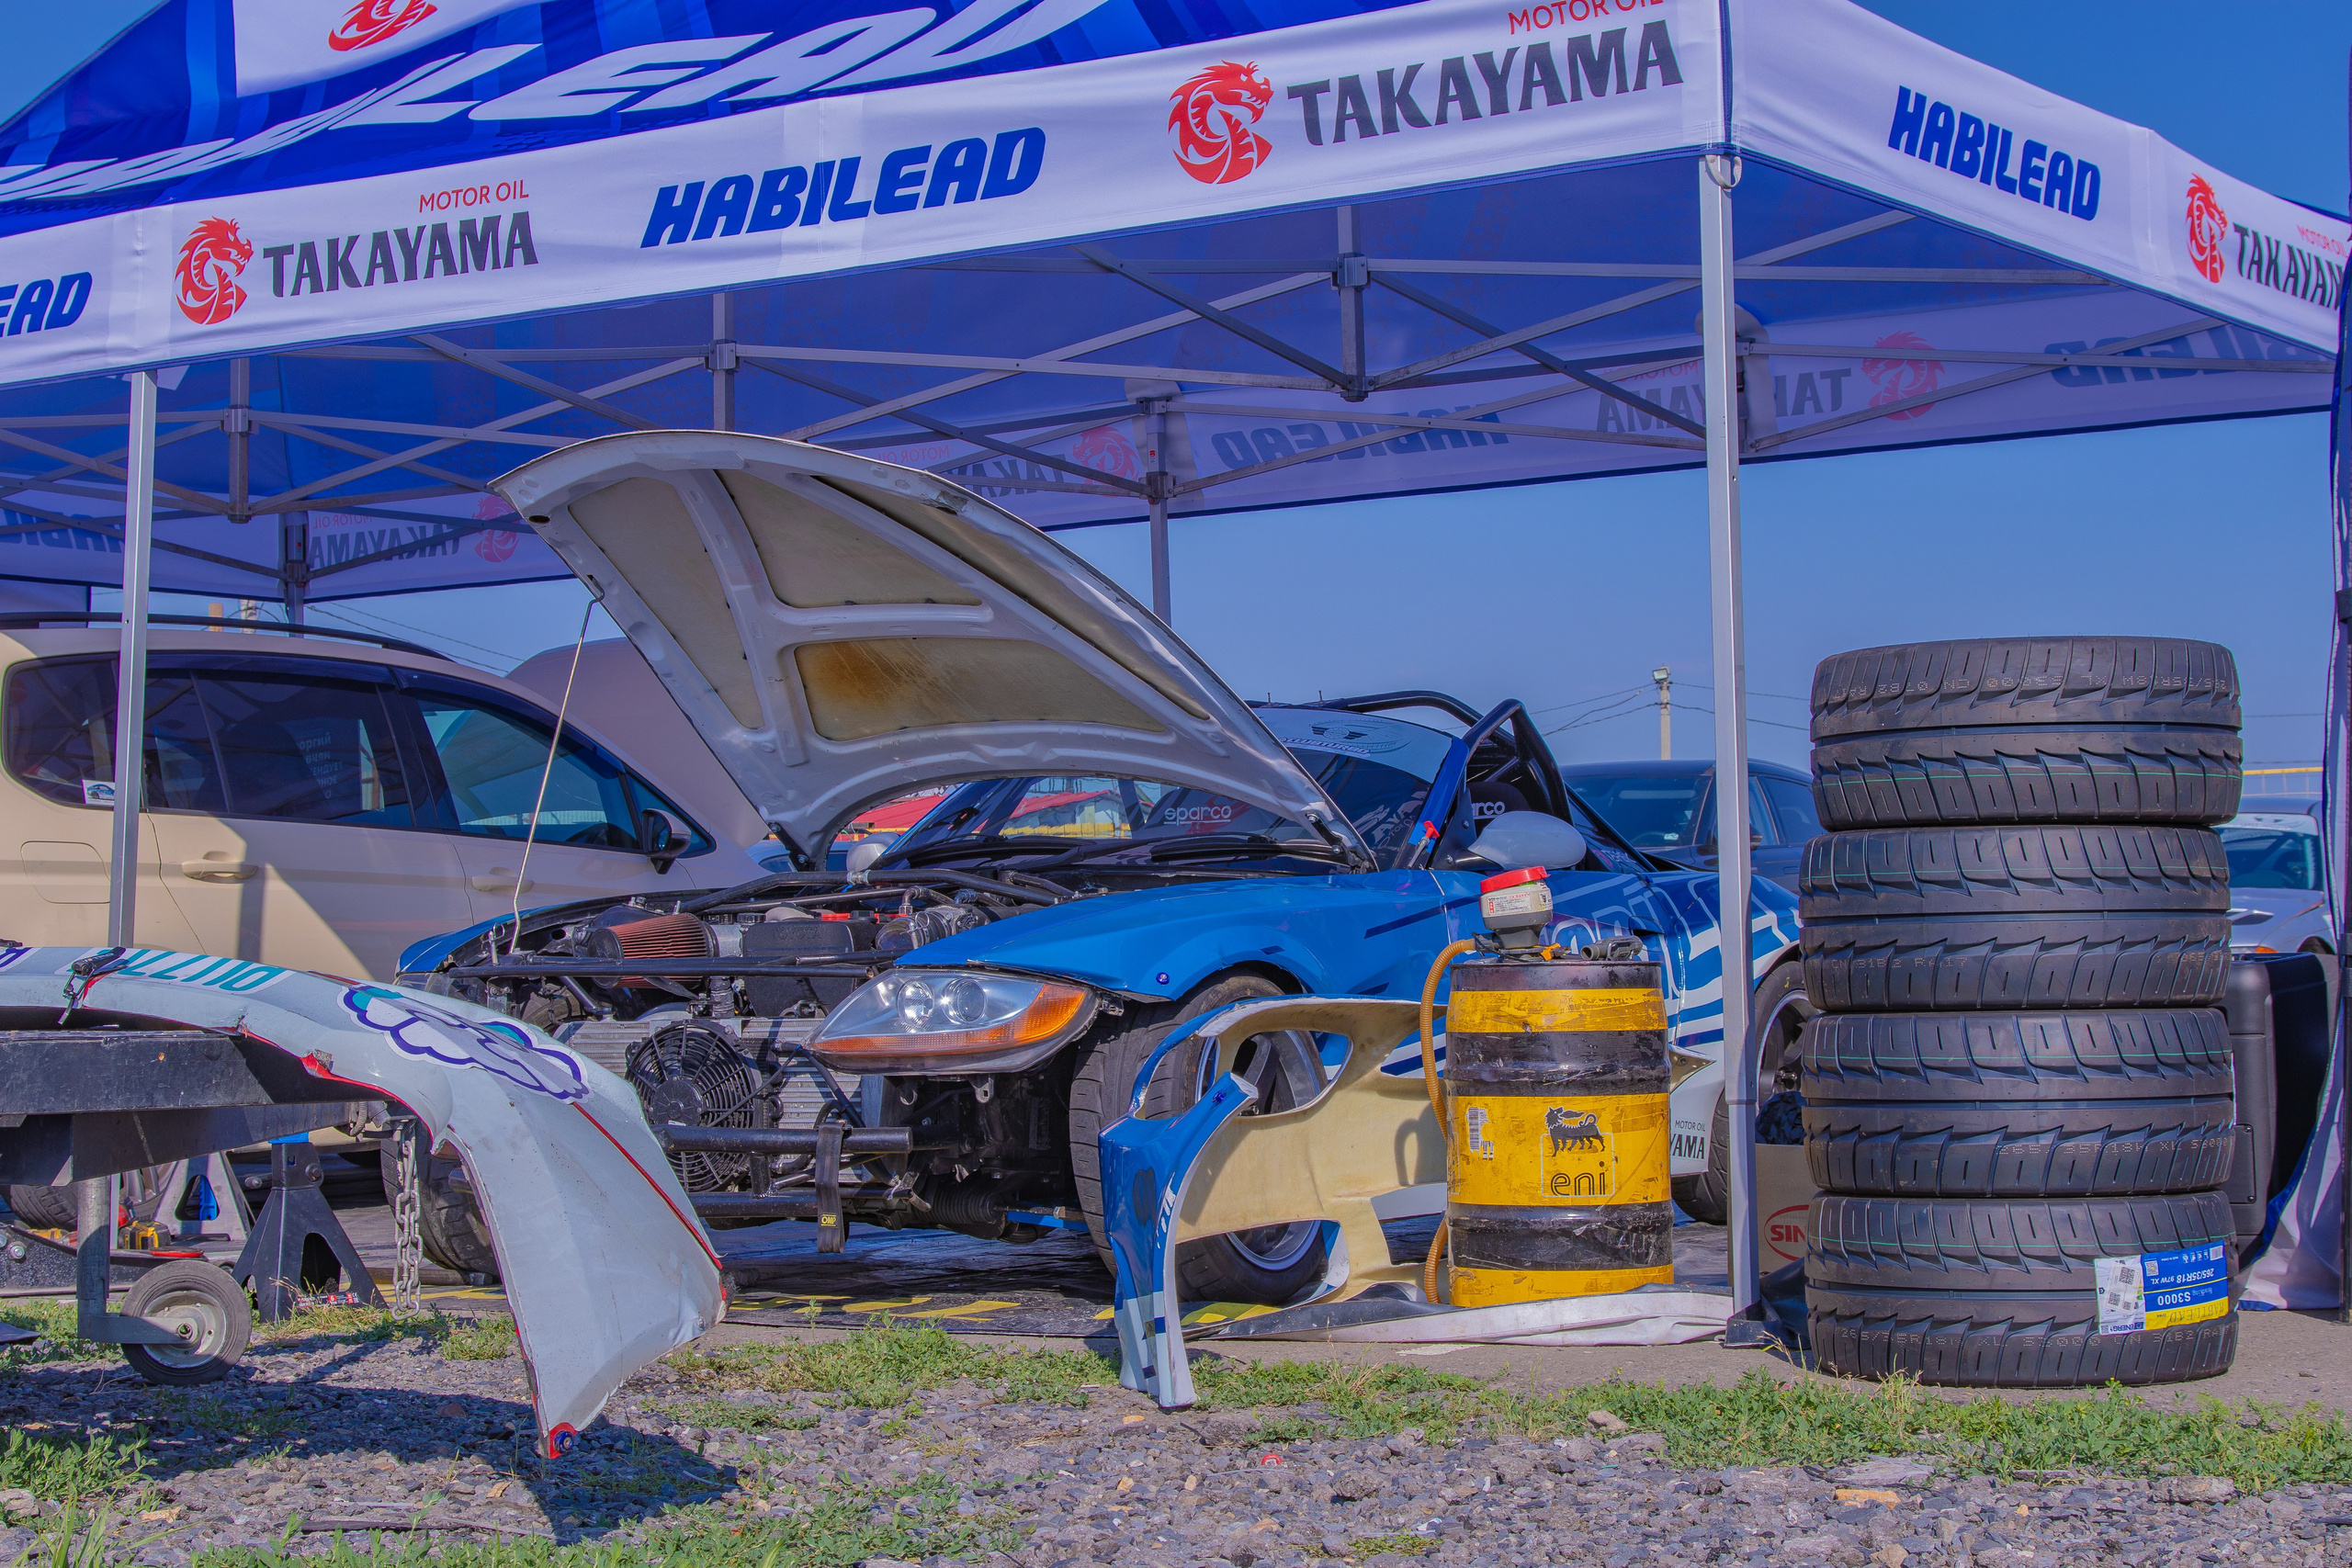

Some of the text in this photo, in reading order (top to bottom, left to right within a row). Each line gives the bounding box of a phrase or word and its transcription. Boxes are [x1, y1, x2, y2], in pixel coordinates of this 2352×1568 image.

[1508, 0, 1611, 35] MOTOR
[1286, 19, 1684, 146] TAKAYAMA
[1887, 85, 2101, 221] HABILEAD
[418, 179, 529, 213] MOTOR OIL
[639, 126, 1046, 249] HABILEAD
[262, 210, 539, 299] TAKAYAMA
[1164, 805, 1232, 827] sparco
[1674, 1119, 1706, 1133] MOTOR OIL
[1550, 1161, 1607, 1197] eni
[821, 1215, 837, 1224] OMP
[2150, 1268, 2215, 1285] 265/35R18 97W XL
[2157, 1291, 2192, 1306] S3000
[2168, 1301, 2225, 1324] HABILEAD
[2113, 1324, 2134, 1332] ENERG
